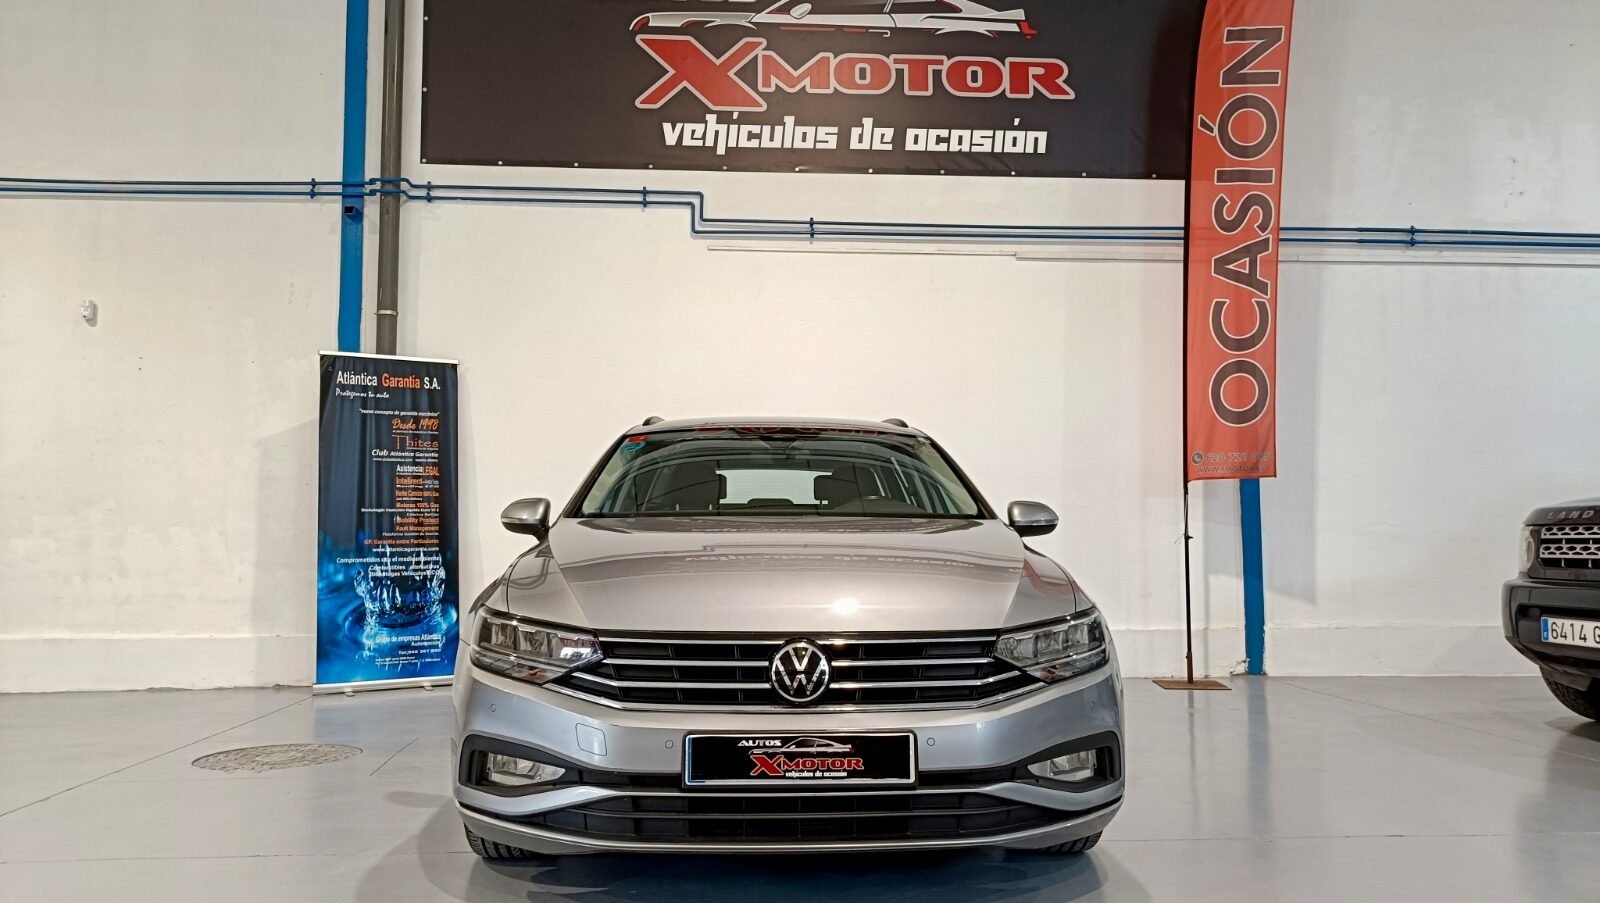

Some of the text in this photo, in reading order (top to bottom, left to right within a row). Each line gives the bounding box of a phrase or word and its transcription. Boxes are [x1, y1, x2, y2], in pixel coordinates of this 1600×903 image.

[635, 34, 1075, 111] XMOTOR
[662, 113, 1048, 155] vehículos de ocasión
[1198, 26, 1285, 426] OCASIÓN
[336, 370, 378, 386] Atlántica
[424, 377, 441, 390] S.A.
[336, 388, 367, 399] Protegemos
[392, 418, 439, 430] Desde 1998
[396, 464, 423, 473] Asistencia
[1547, 510, 1595, 520] LAND
[1550, 622, 1587, 643] 6414
[750, 755, 864, 776] XMOTOR
